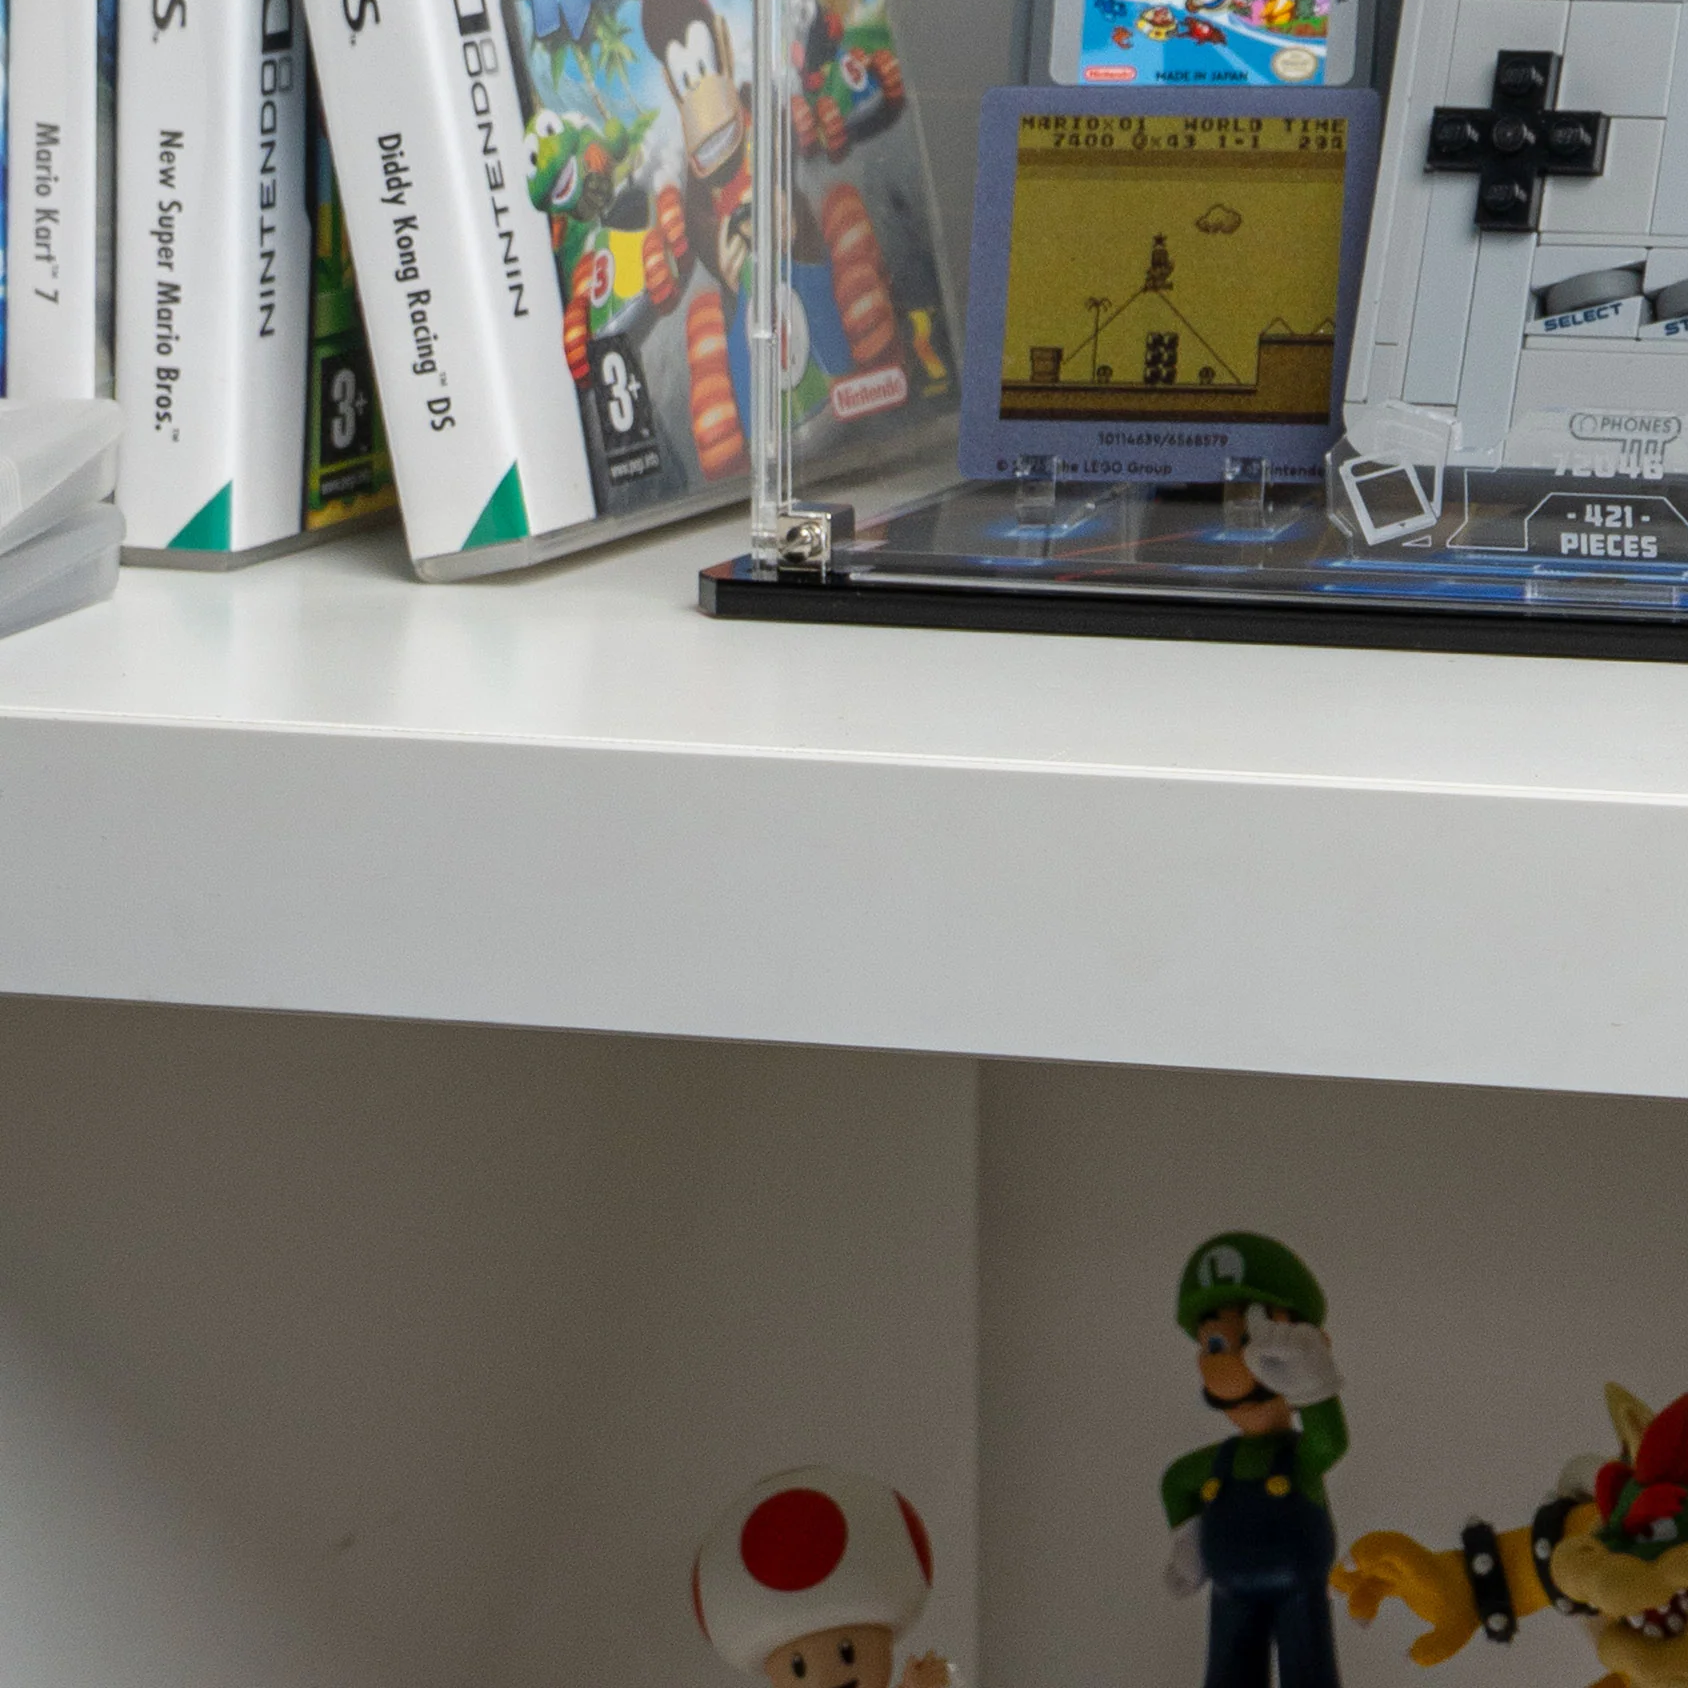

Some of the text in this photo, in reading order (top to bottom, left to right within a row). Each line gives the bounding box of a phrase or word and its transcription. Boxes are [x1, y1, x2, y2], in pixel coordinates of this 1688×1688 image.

[1155, 70, 1189, 82] MADE
[1193, 70, 1207, 82] IN
[1211, 70, 1250, 82] JAPAN
[1184, 116, 1263, 132] WORLD
[1284, 118, 1347, 133] TIME
[159, 128, 184, 189] New
[34, 121, 60, 305] Mario Kart 7
[149, 199, 182, 273] Super
[377, 131, 408, 207] Diddy
[393, 214, 420, 284] Kong
[407, 288, 438, 376] Racing
[427, 395, 456, 431] DS
[156, 281, 182, 357] Mario
[1543, 302, 1623, 332] SELECT
[154, 366, 180, 432] Bros.
[1600, 416, 1672, 434] PHONES
[1083, 461, 1123, 474] LEGO
[1127, 461, 1173, 475] Group
[1551, 452, 1664, 480] 72046
[1584, 503, 1633, 529] 421
[1559, 532, 1658, 559] PIECES
[1210, 1257, 1235, 1286] L
